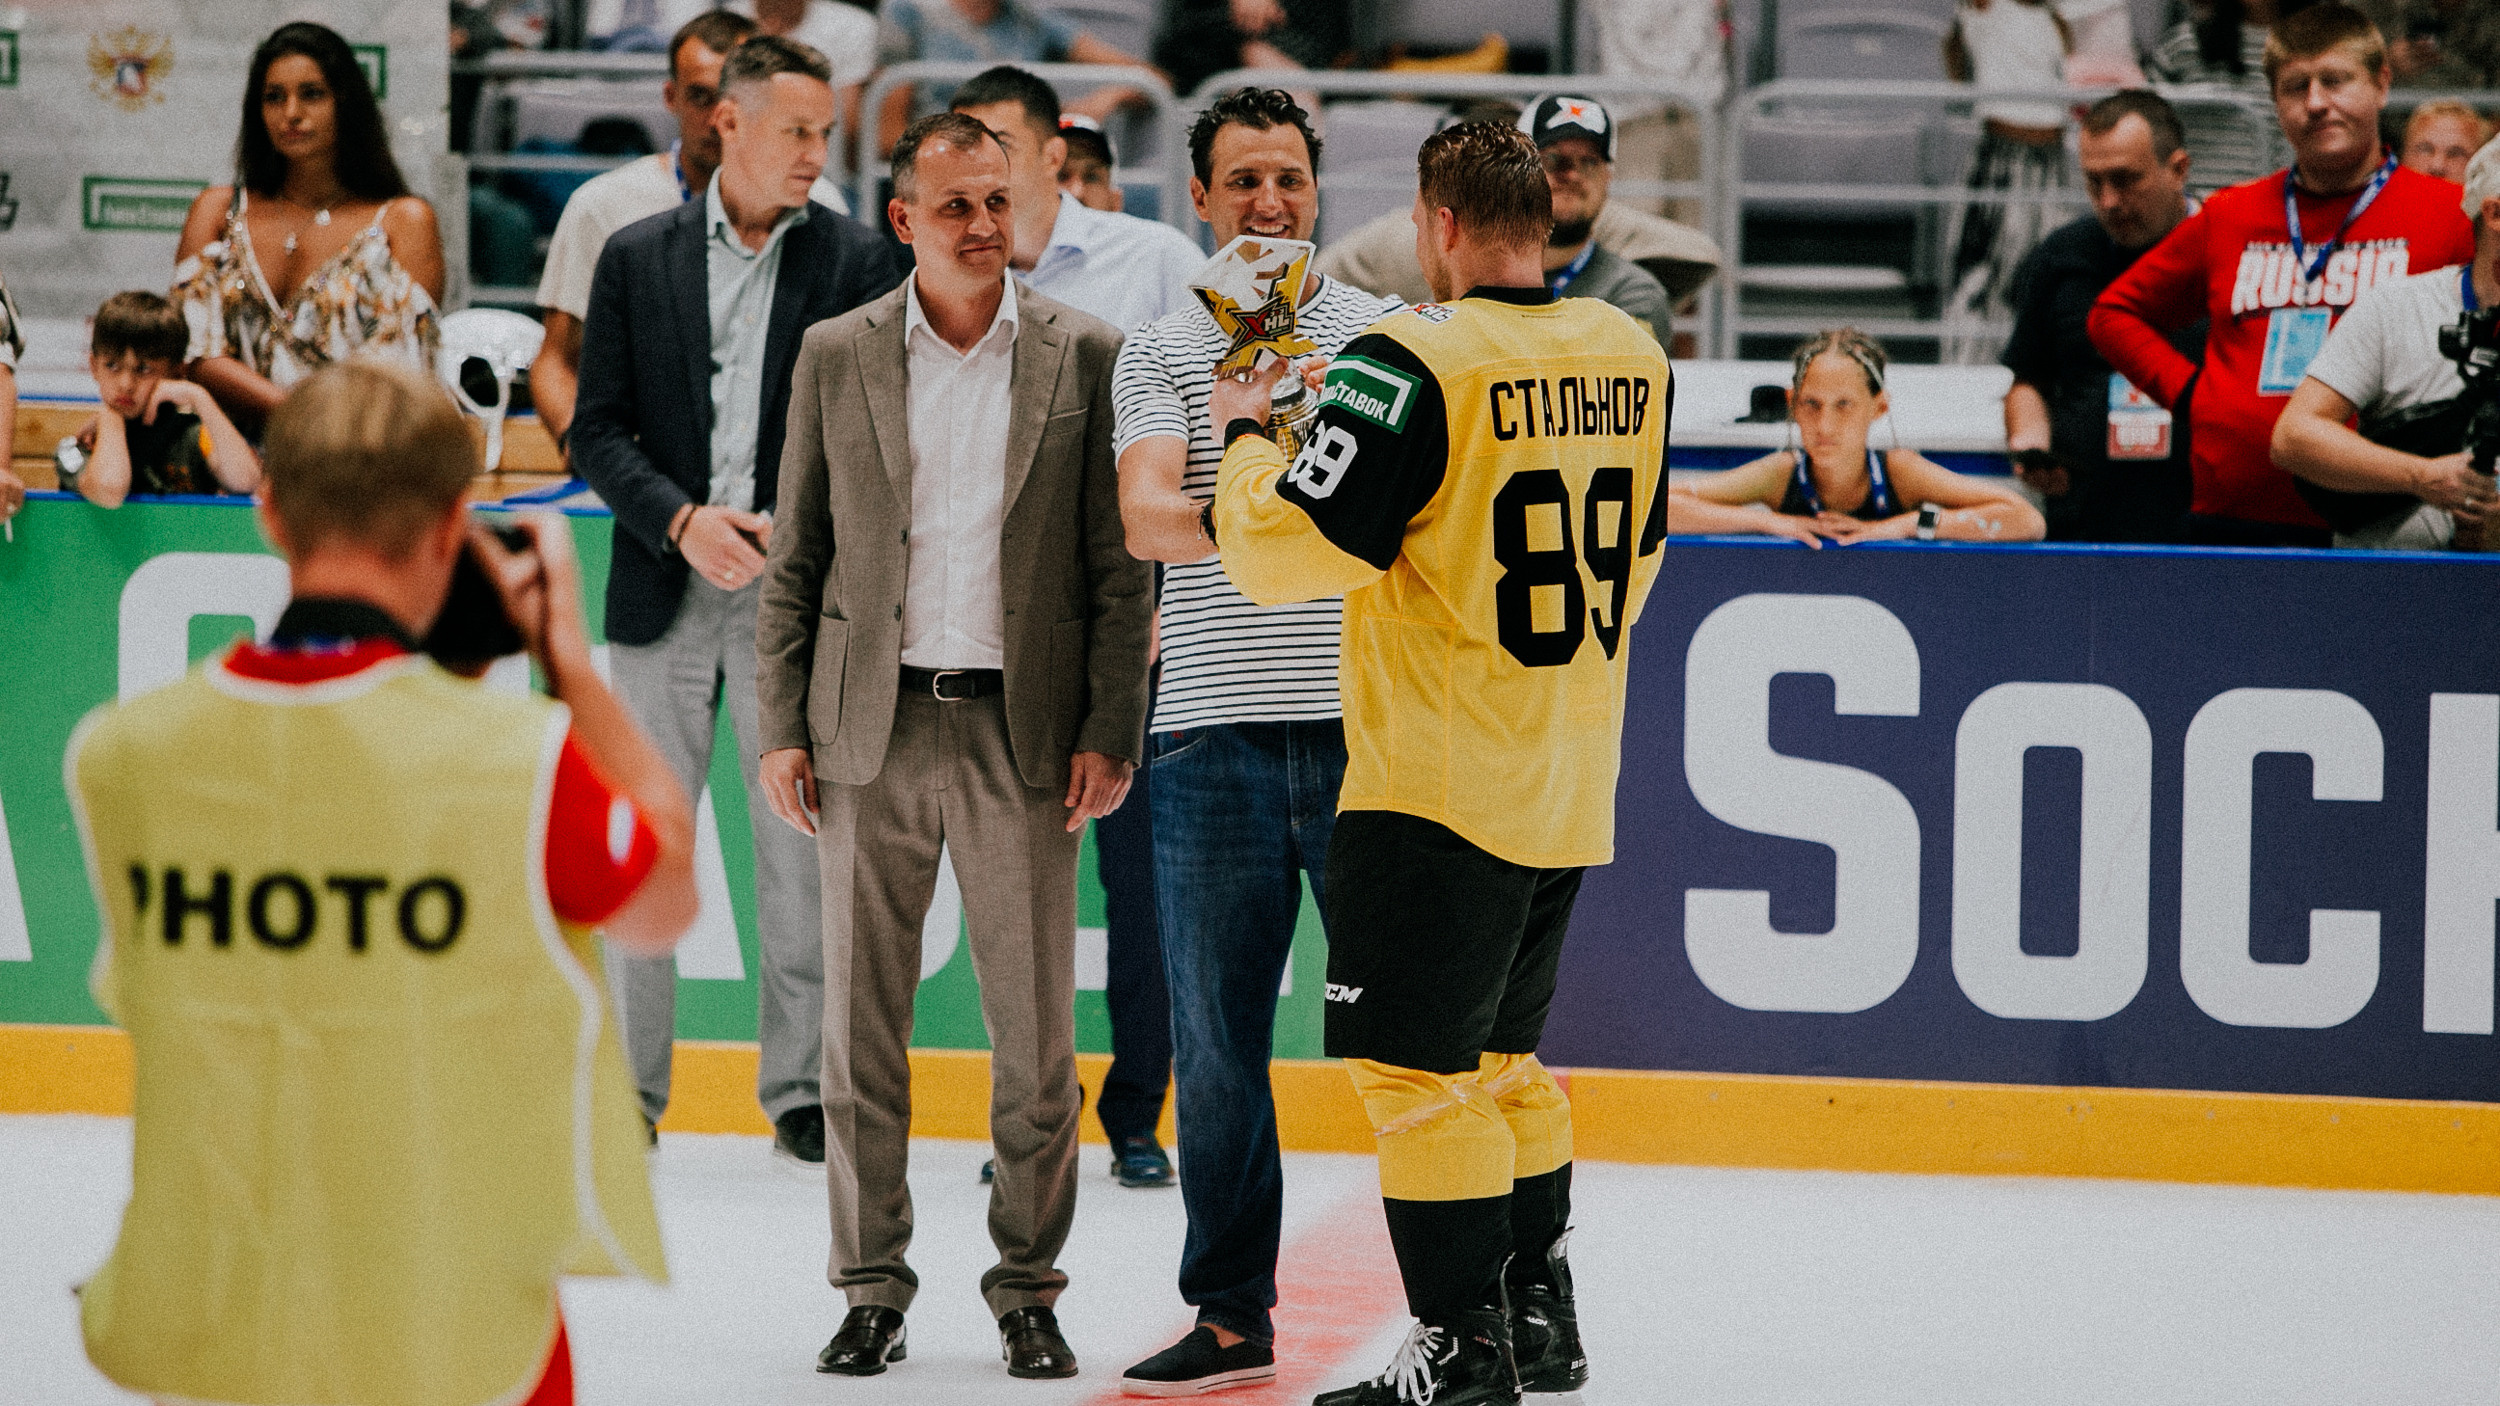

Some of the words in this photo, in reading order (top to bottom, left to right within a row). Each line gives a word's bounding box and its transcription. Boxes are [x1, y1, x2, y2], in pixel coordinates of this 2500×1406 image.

[1489, 376, 1650, 441] СТАЛЬНОВ
[1287, 420, 1358, 500] 89
[1493, 467, 1634, 667] 89
[1325, 982, 1364, 1003] CM
